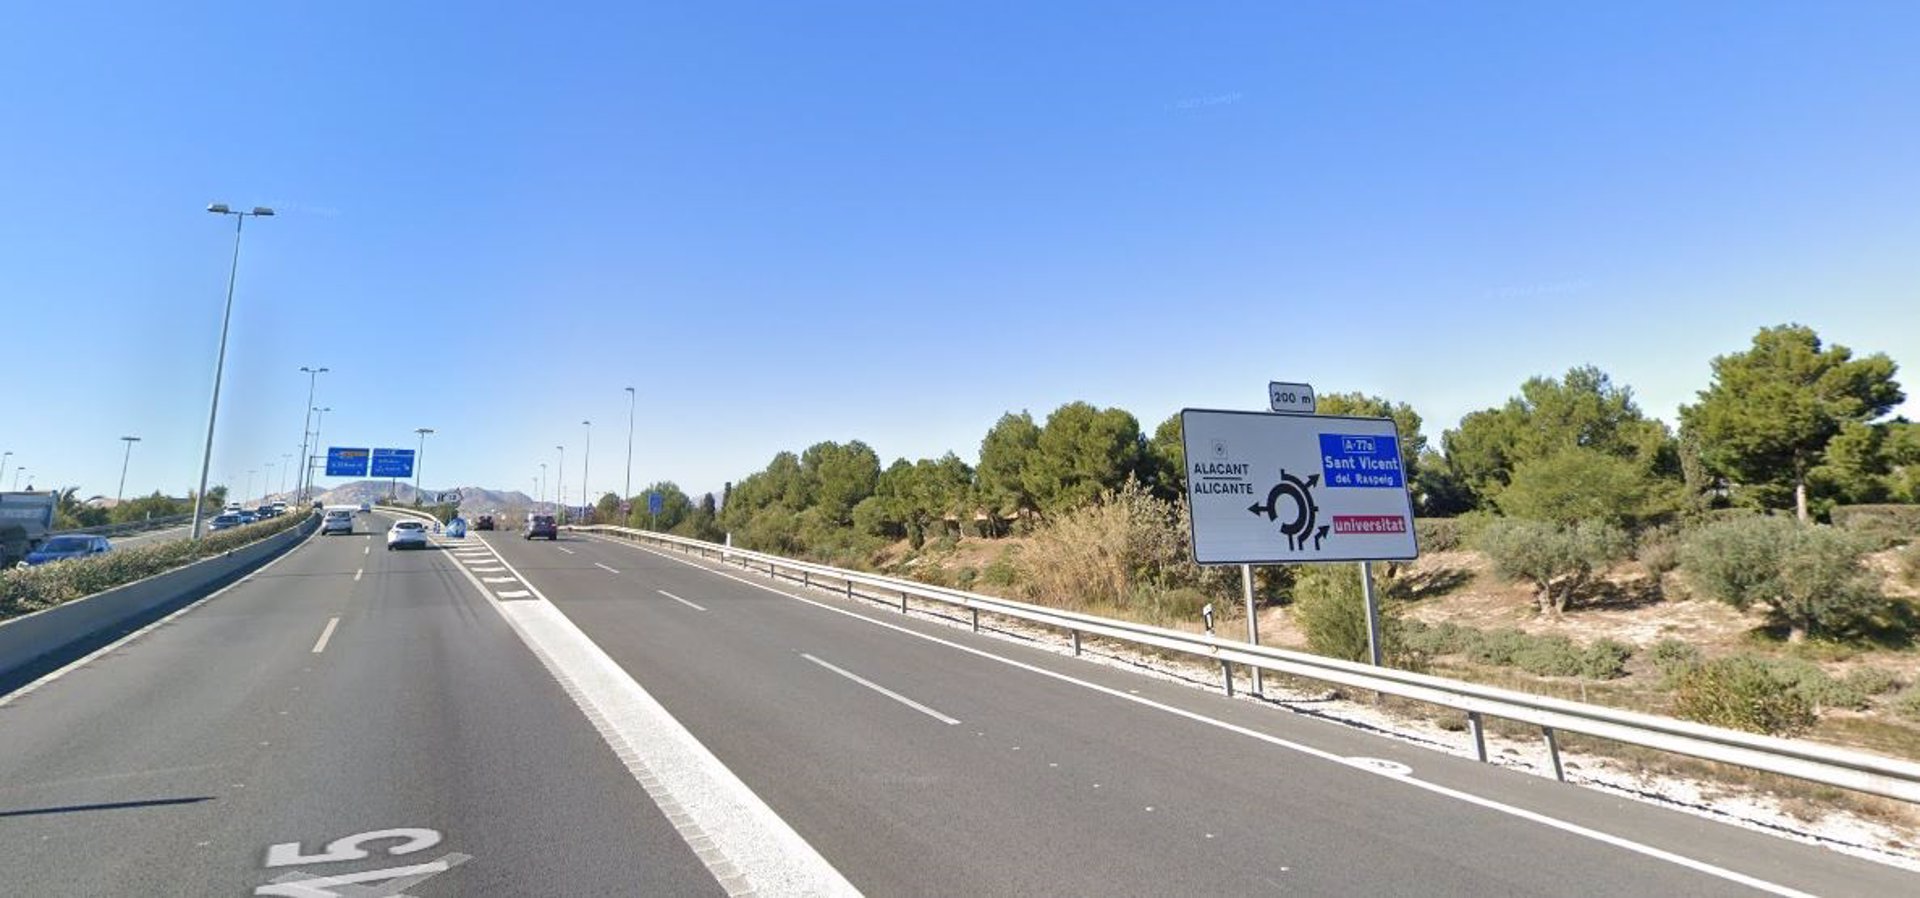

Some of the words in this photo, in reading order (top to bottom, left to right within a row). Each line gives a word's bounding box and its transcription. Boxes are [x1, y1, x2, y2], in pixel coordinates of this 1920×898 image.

[1273, 391, 1297, 404] 200
[1301, 395, 1312, 404] m
[1324, 455, 1356, 469] Sant
[1358, 456, 1400, 470] Vicent
[1194, 463, 1250, 476] ALACANT
[1335, 474, 1351, 484] del
[1356, 474, 1394, 487] Raspeig
[1194, 482, 1255, 495] ALICANTE
[1335, 518, 1406, 532] universitat
